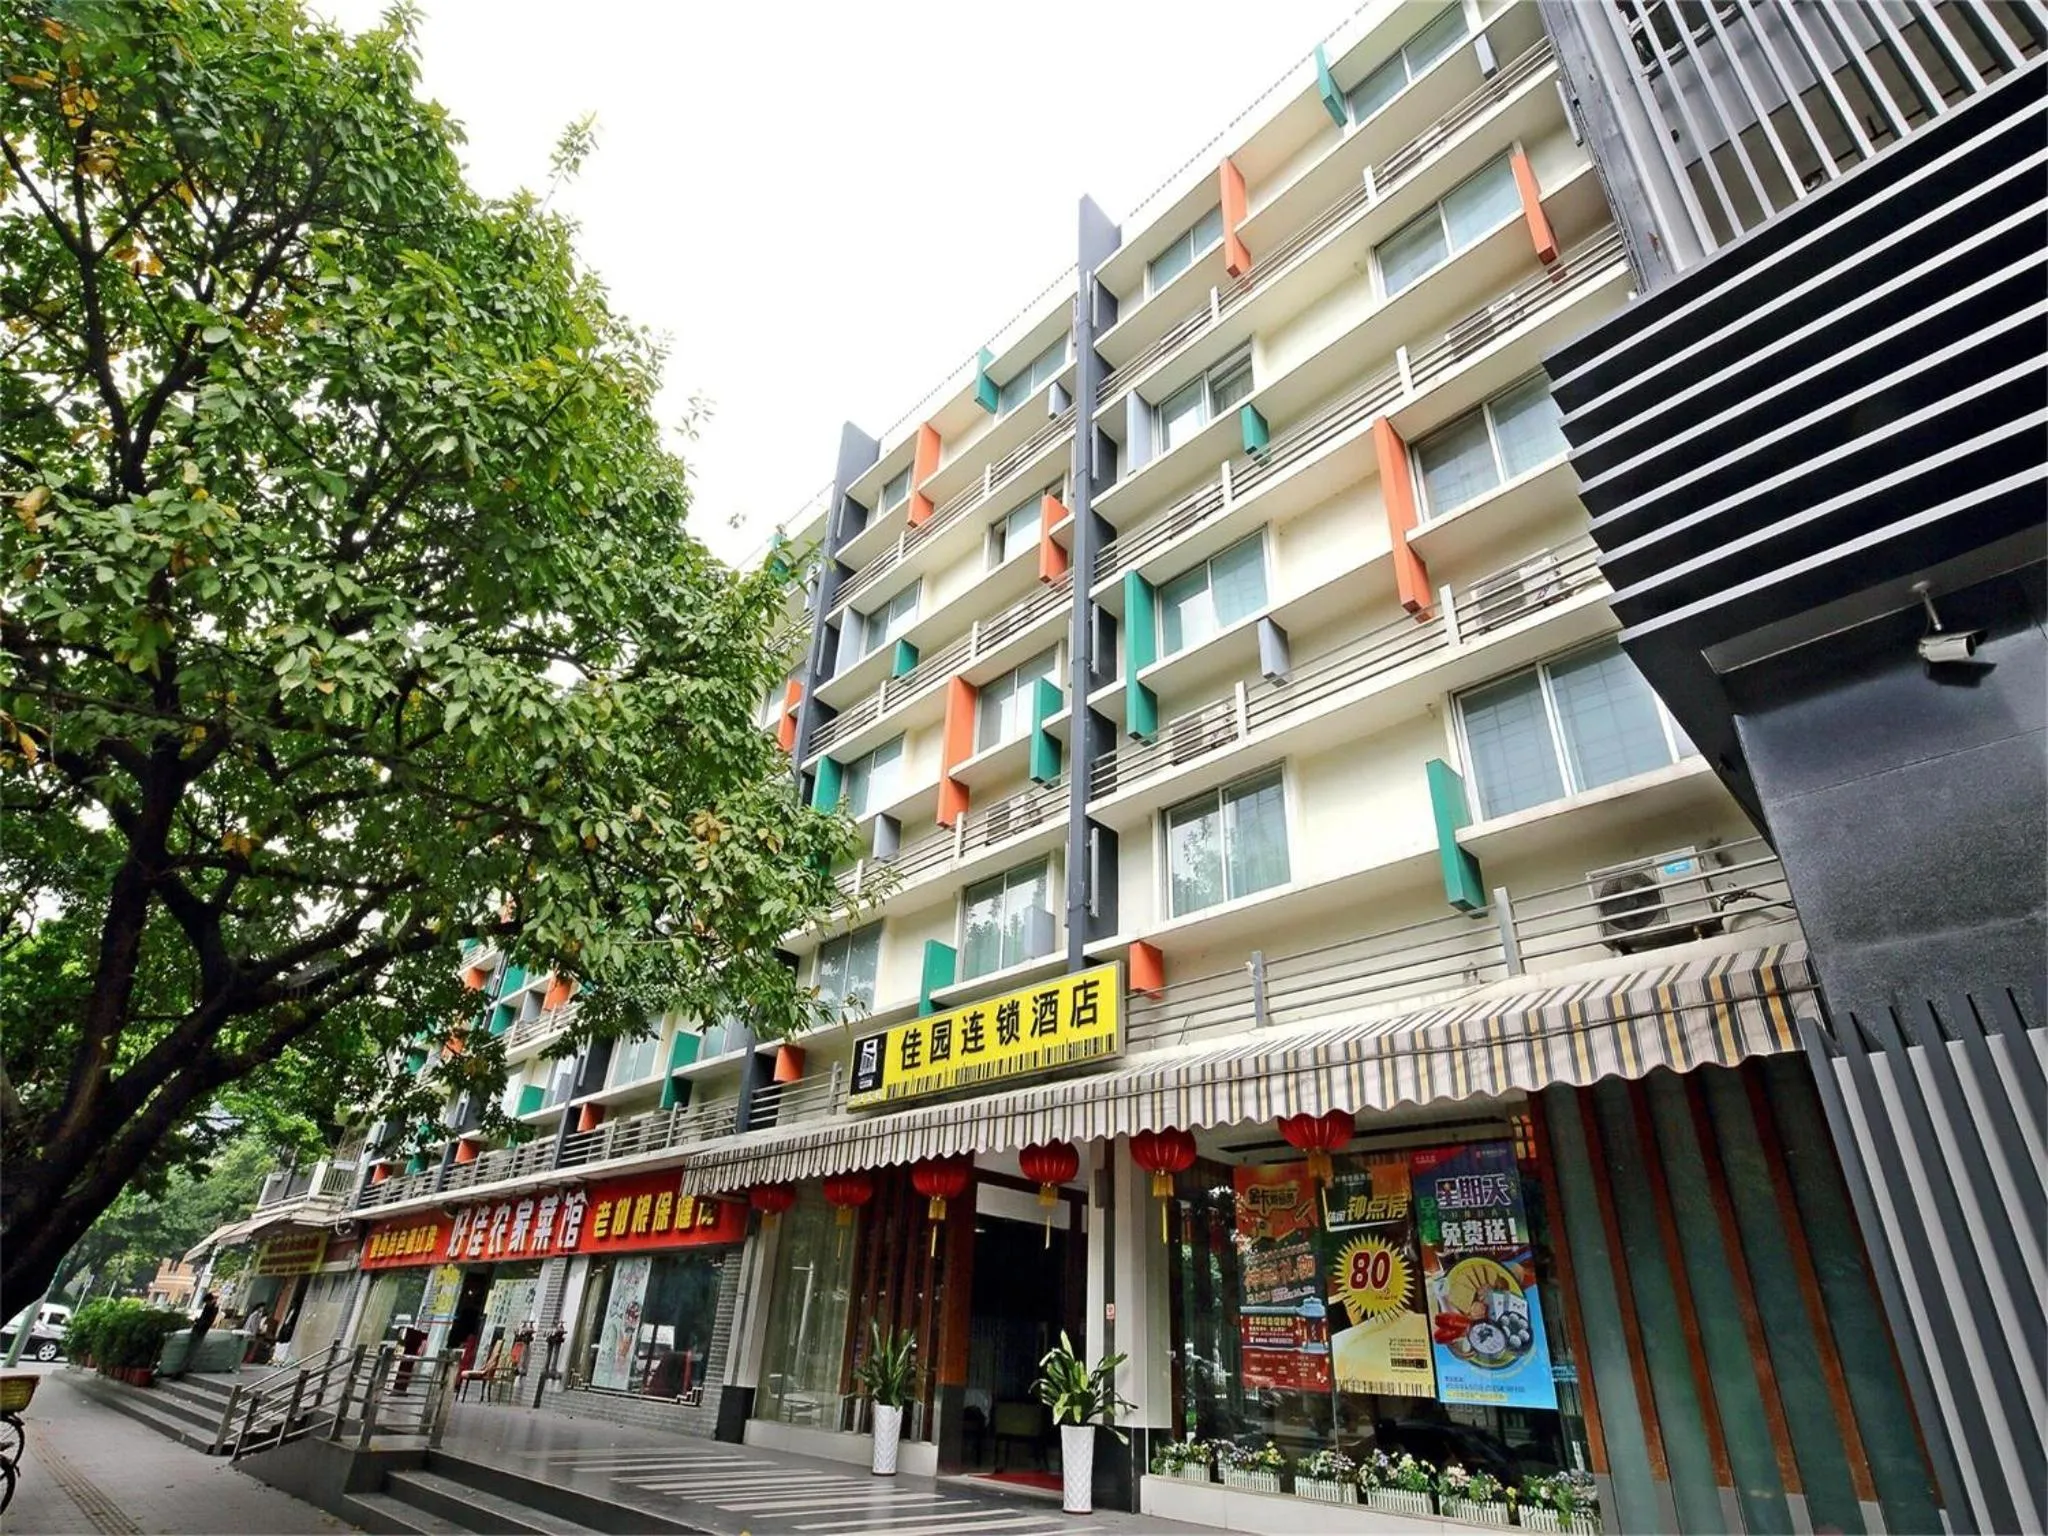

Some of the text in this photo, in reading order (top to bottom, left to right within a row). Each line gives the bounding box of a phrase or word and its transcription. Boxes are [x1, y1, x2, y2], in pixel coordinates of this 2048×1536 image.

[900, 979, 1100, 1071] 佳园连锁酒店
[1346, 1193, 1409, 1221] 钟点房
[1436, 1173, 1512, 1209] 星期天
[446, 1190, 586, 1257] 好佳农家菜馆
[1350, 1250, 1392, 1290] 80
